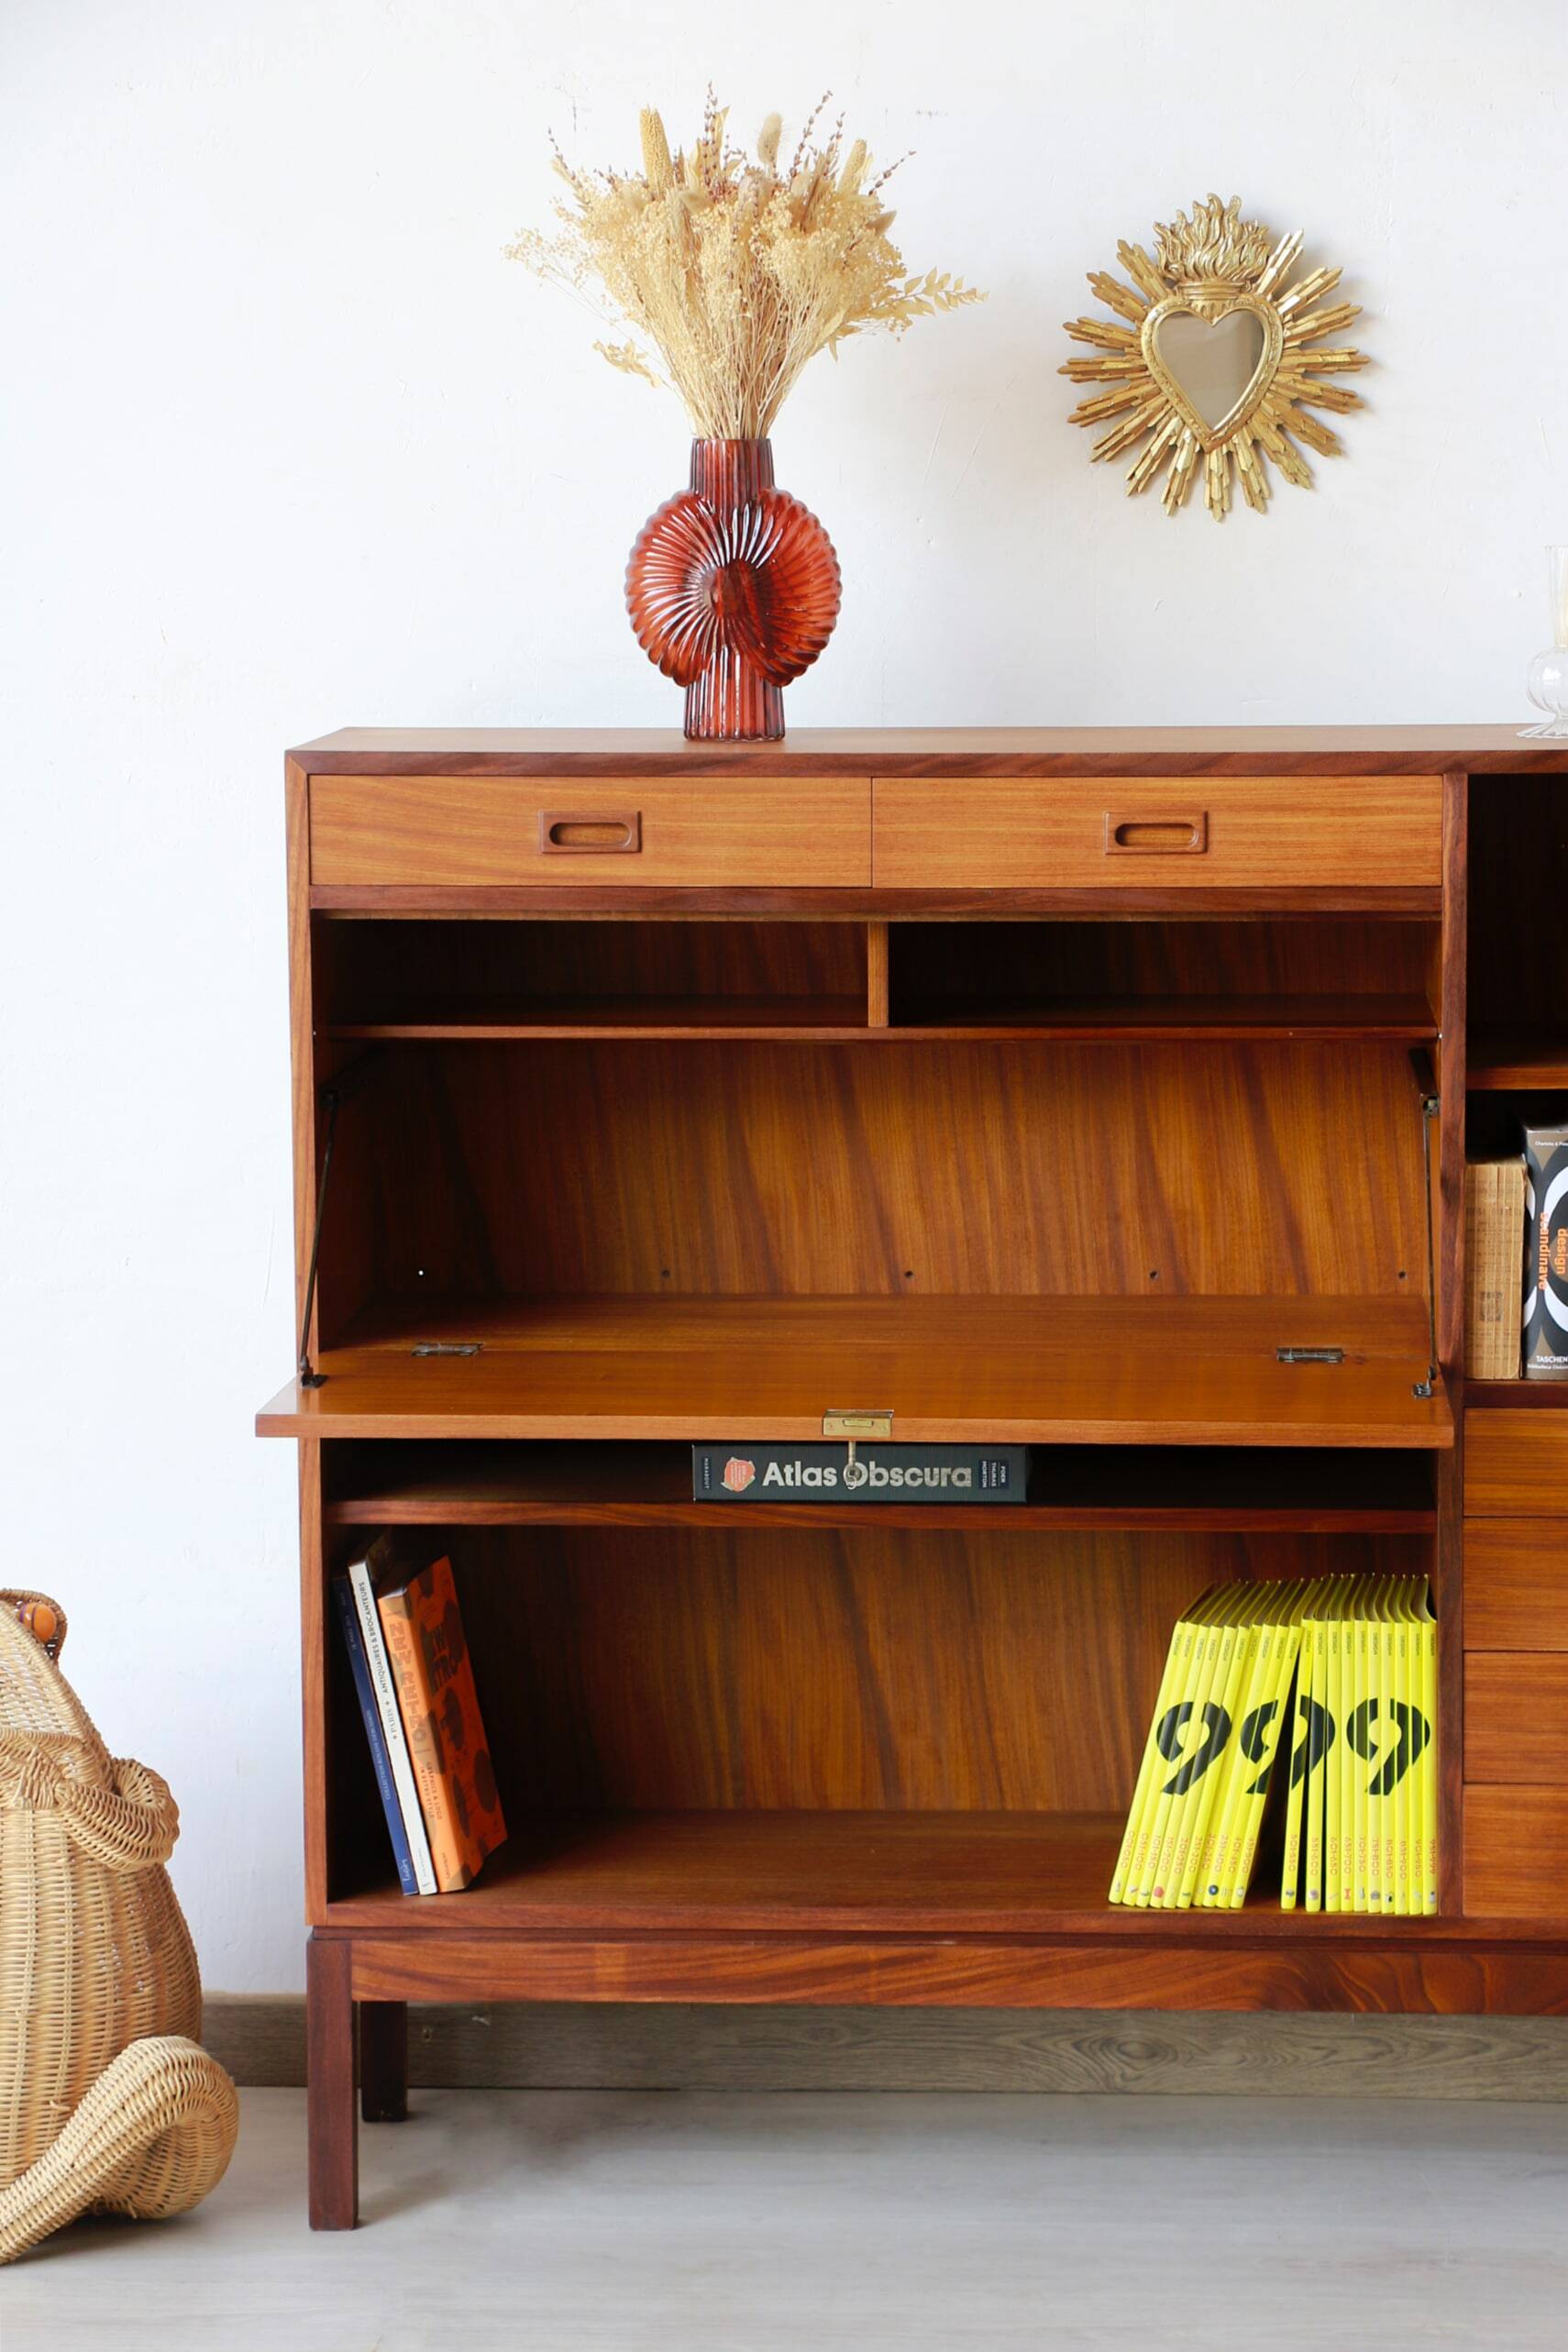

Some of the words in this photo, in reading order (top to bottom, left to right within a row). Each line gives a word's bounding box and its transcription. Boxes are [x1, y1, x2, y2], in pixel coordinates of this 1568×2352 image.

[1538, 1211, 1551, 1291] scandinave
[1555, 1227, 1568, 1275] design
[762, 1462, 838, 1487] Atlas
[844, 1461, 972, 1488] Obscura
[359, 1581, 376, 1637] BROCANTEURS
[372, 1644, 389, 1694] ANTIQUAIRES
[389, 1620, 414, 1666] NEW
[403, 1671, 426, 1741] RETRO
[386, 1708, 397, 1733] PARIS
[425, 1761, 437, 1794] GRAPHICS
